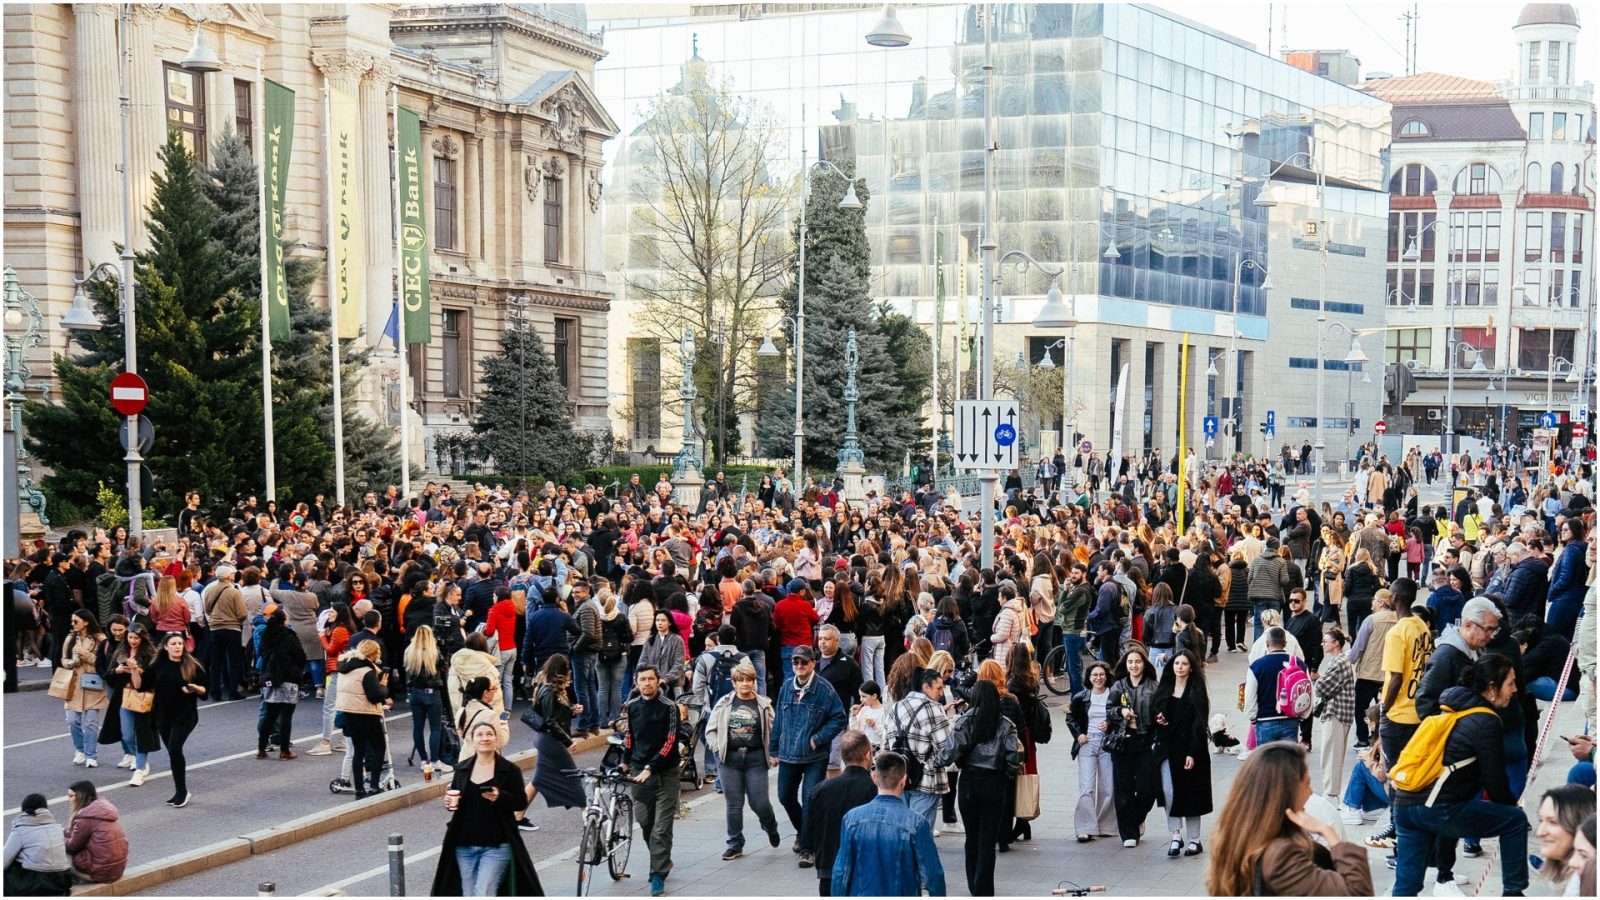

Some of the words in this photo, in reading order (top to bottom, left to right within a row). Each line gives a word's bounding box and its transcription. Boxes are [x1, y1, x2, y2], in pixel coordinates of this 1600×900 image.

[404, 147, 420, 220] Bank
[405, 256, 422, 312] CEC
[1524, 393, 1568, 402] VICTRIA
